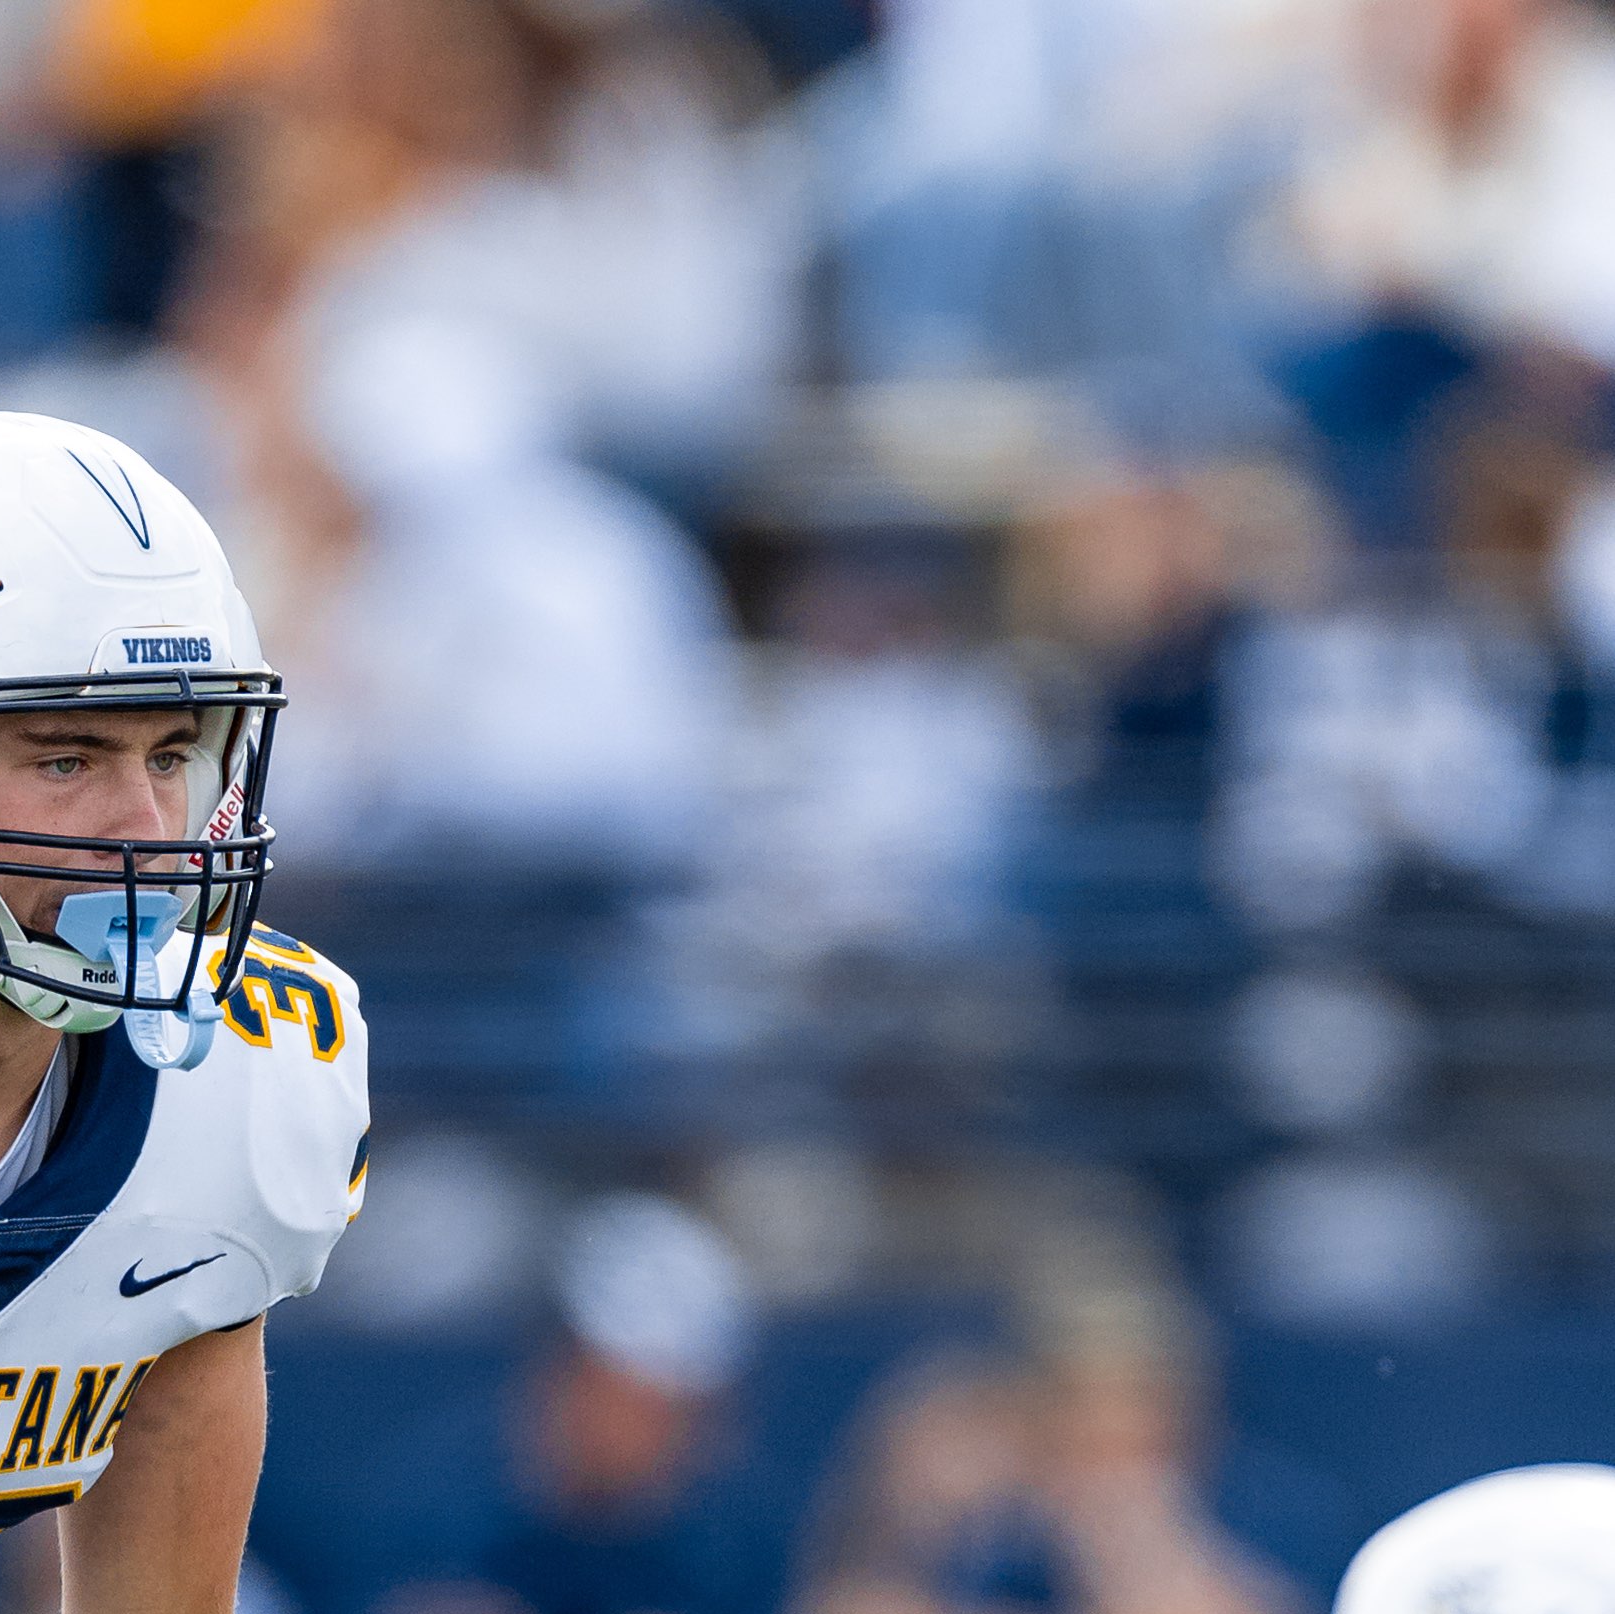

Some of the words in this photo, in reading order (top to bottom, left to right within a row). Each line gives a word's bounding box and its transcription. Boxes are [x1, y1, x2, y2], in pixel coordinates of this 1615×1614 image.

[122, 637, 212, 664] VIKINGS
[188, 782, 246, 869] Rddell
[82, 967, 121, 984] Ridd
